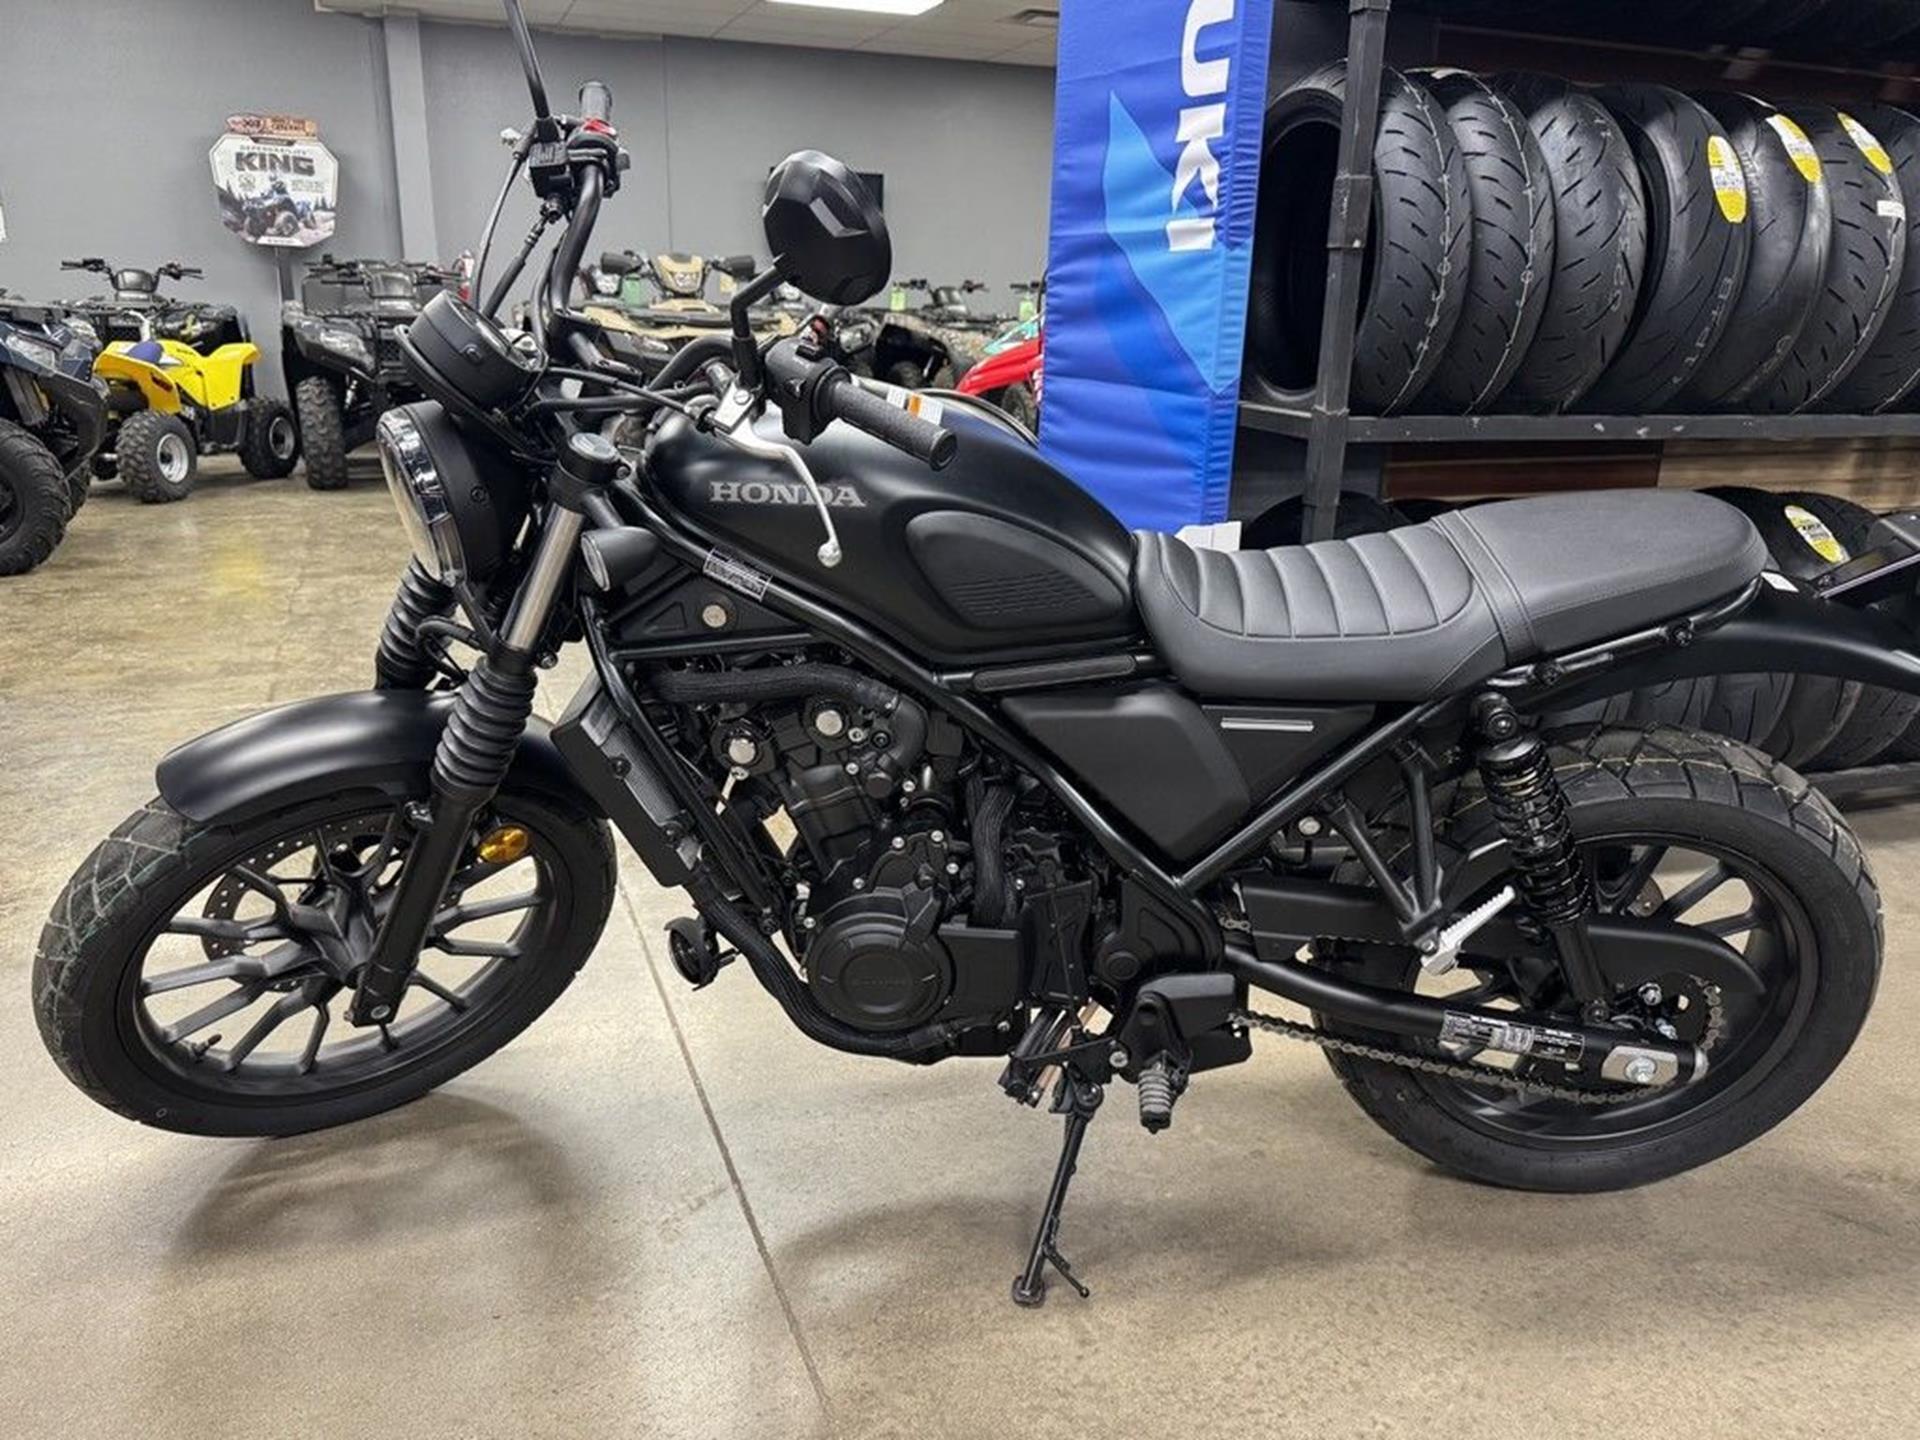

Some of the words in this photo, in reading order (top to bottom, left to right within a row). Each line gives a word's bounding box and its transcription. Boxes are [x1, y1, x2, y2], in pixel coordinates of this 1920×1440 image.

[1166, 0, 1234, 253] UKI
[235, 152, 315, 176] KING
[709, 480, 867, 508] HONDA
